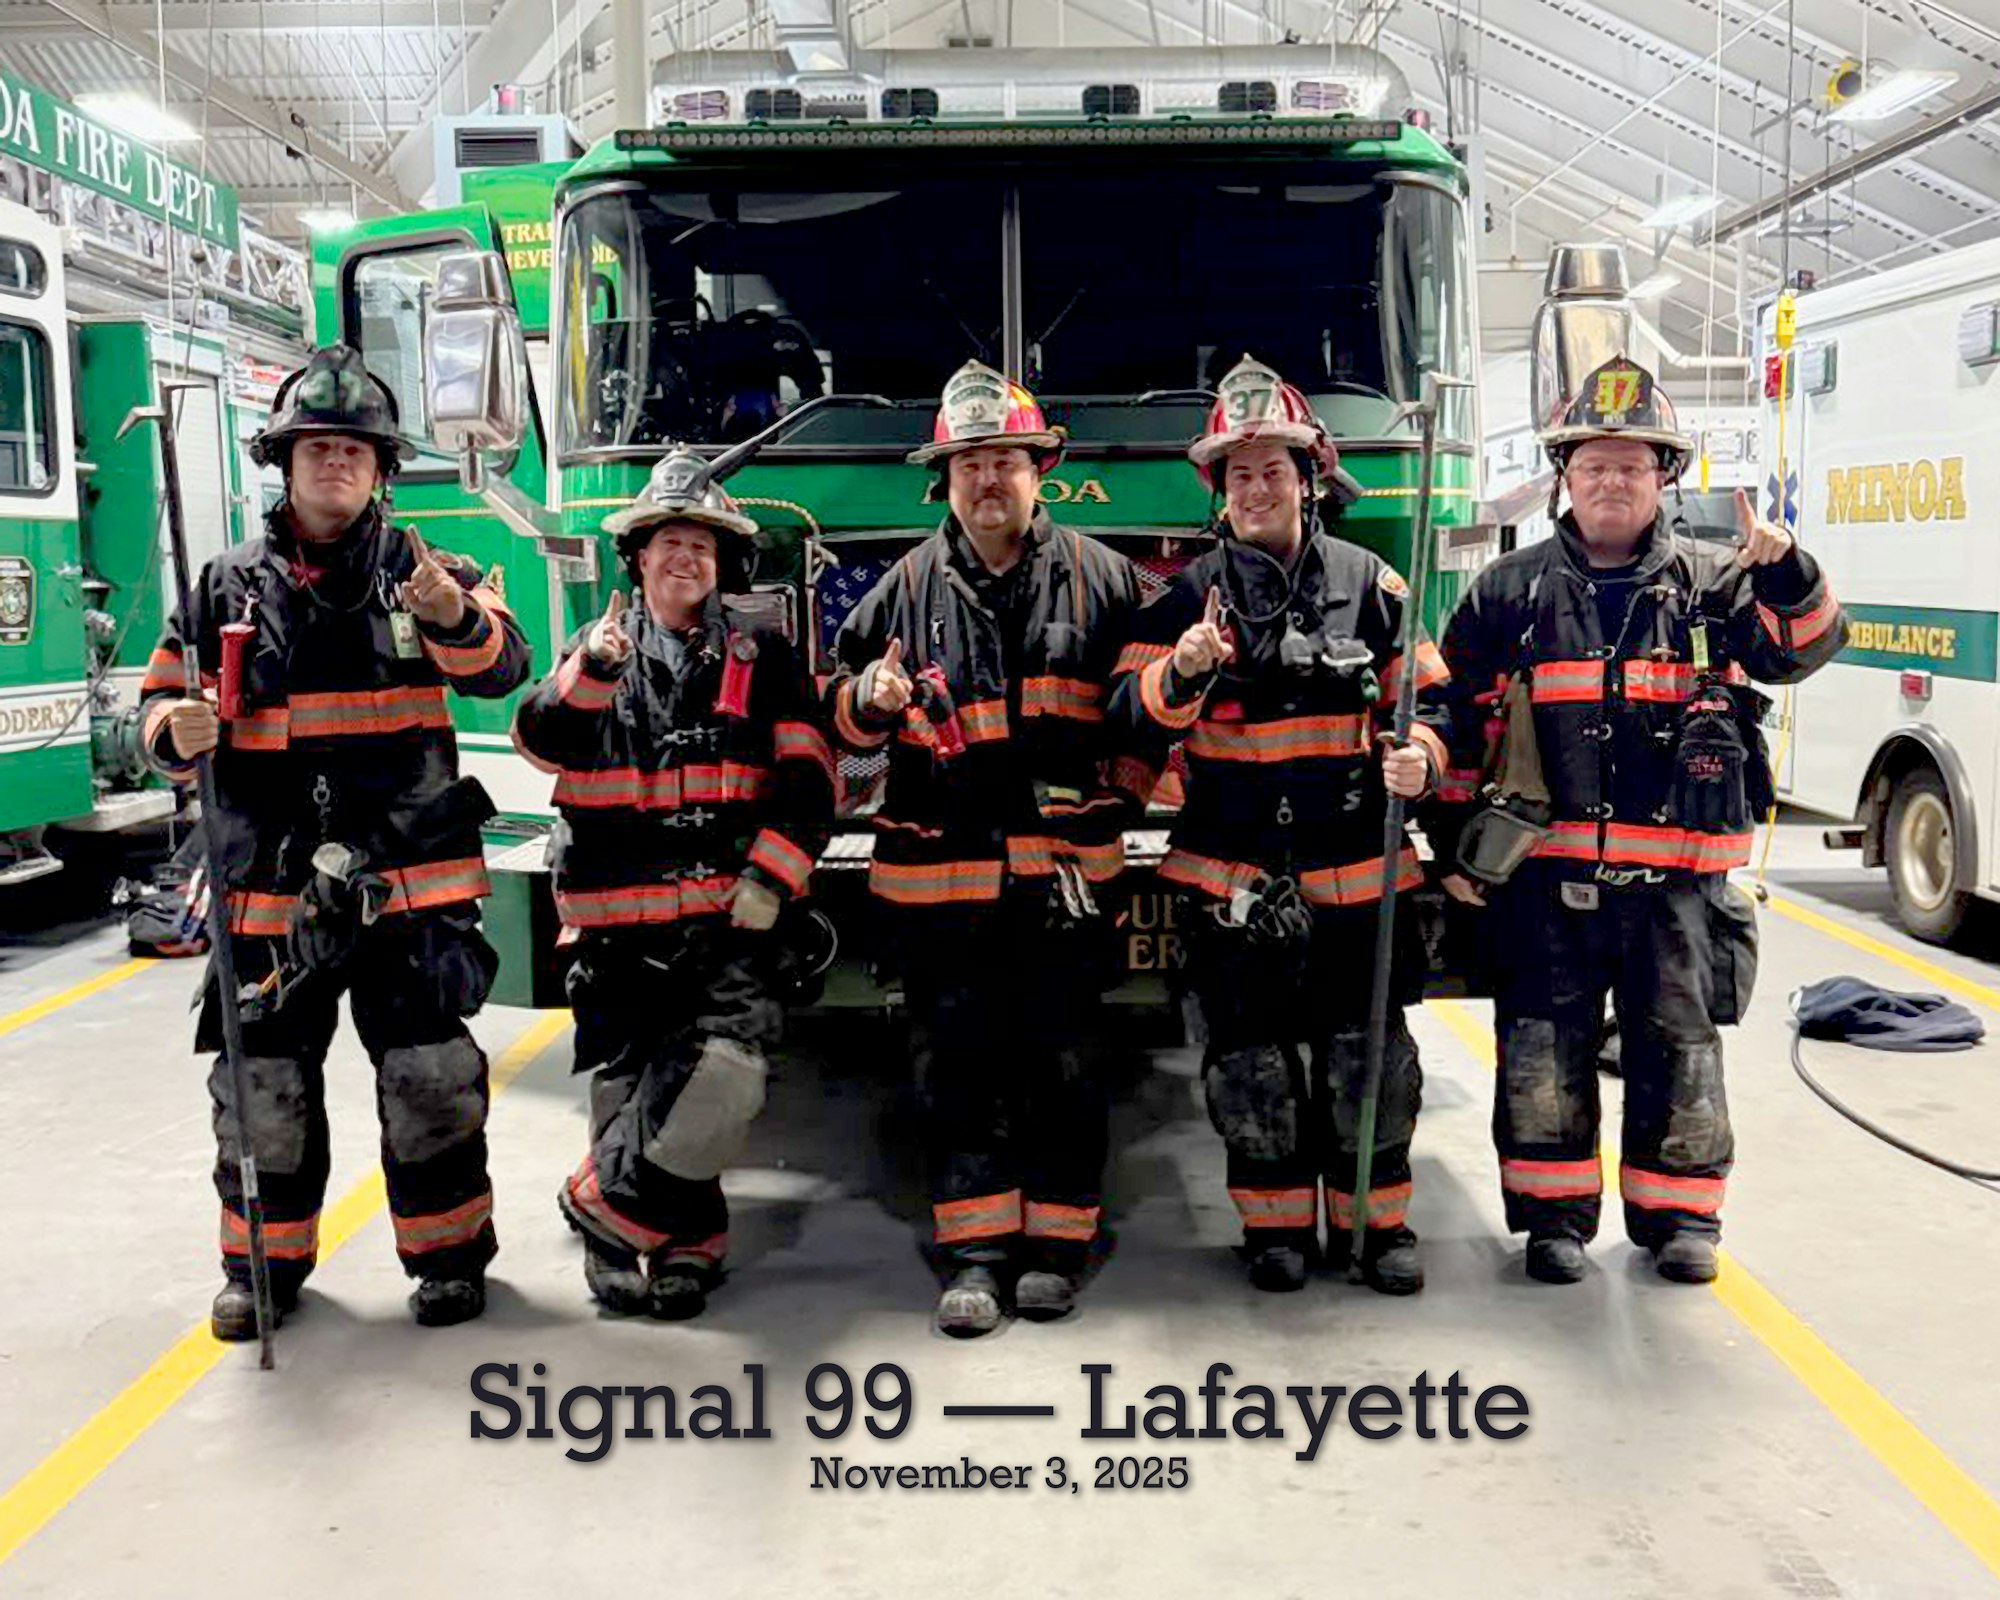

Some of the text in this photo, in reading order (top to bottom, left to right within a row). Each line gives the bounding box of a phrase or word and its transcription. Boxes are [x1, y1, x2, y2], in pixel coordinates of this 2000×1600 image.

[54, 106, 133, 195] FIRE
[144, 151, 224, 235] DEPT.
[1228, 388, 1272, 421] 37
[662, 471, 695, 493] 37
[1826, 457, 1966, 524] MINOA
[1850, 621, 1956, 658] MBULANCE
